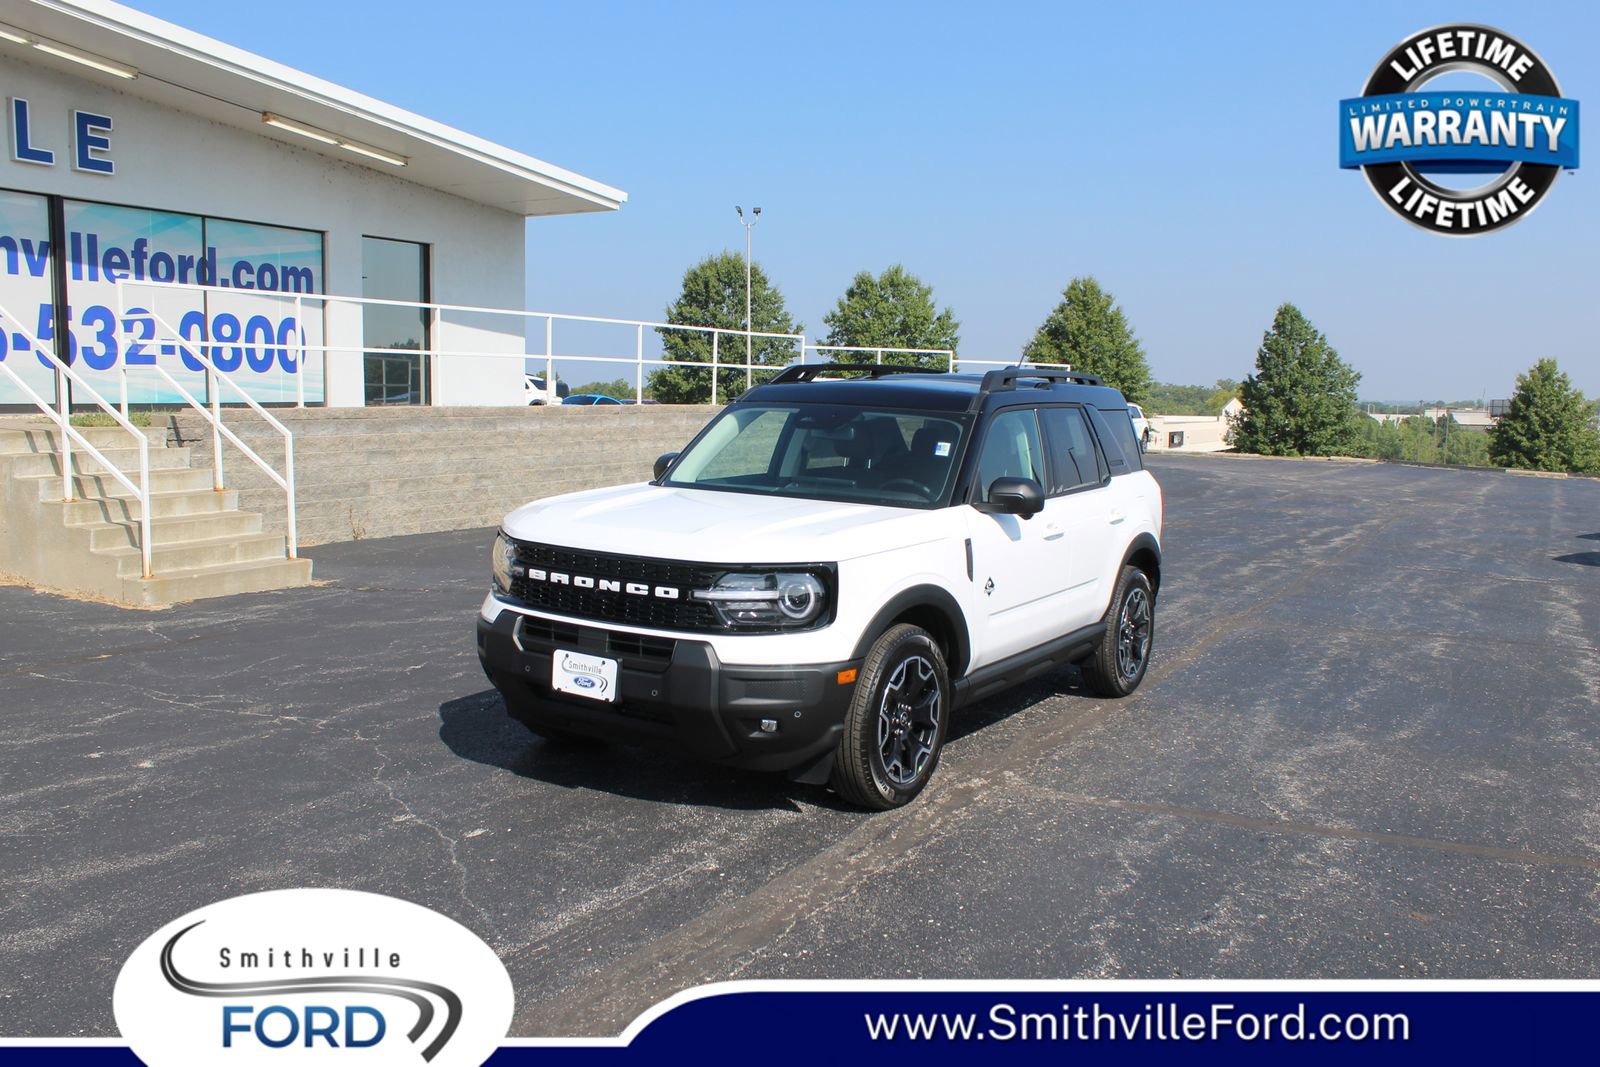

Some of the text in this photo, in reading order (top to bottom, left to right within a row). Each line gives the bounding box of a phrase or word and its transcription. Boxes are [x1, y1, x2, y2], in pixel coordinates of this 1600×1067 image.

[0, 231, 315, 295] vlleford.com
[0, 302, 307, 374] -532-0800
[528, 568, 679, 599] BRONCO
[568, 660, 602, 675] Smithville
